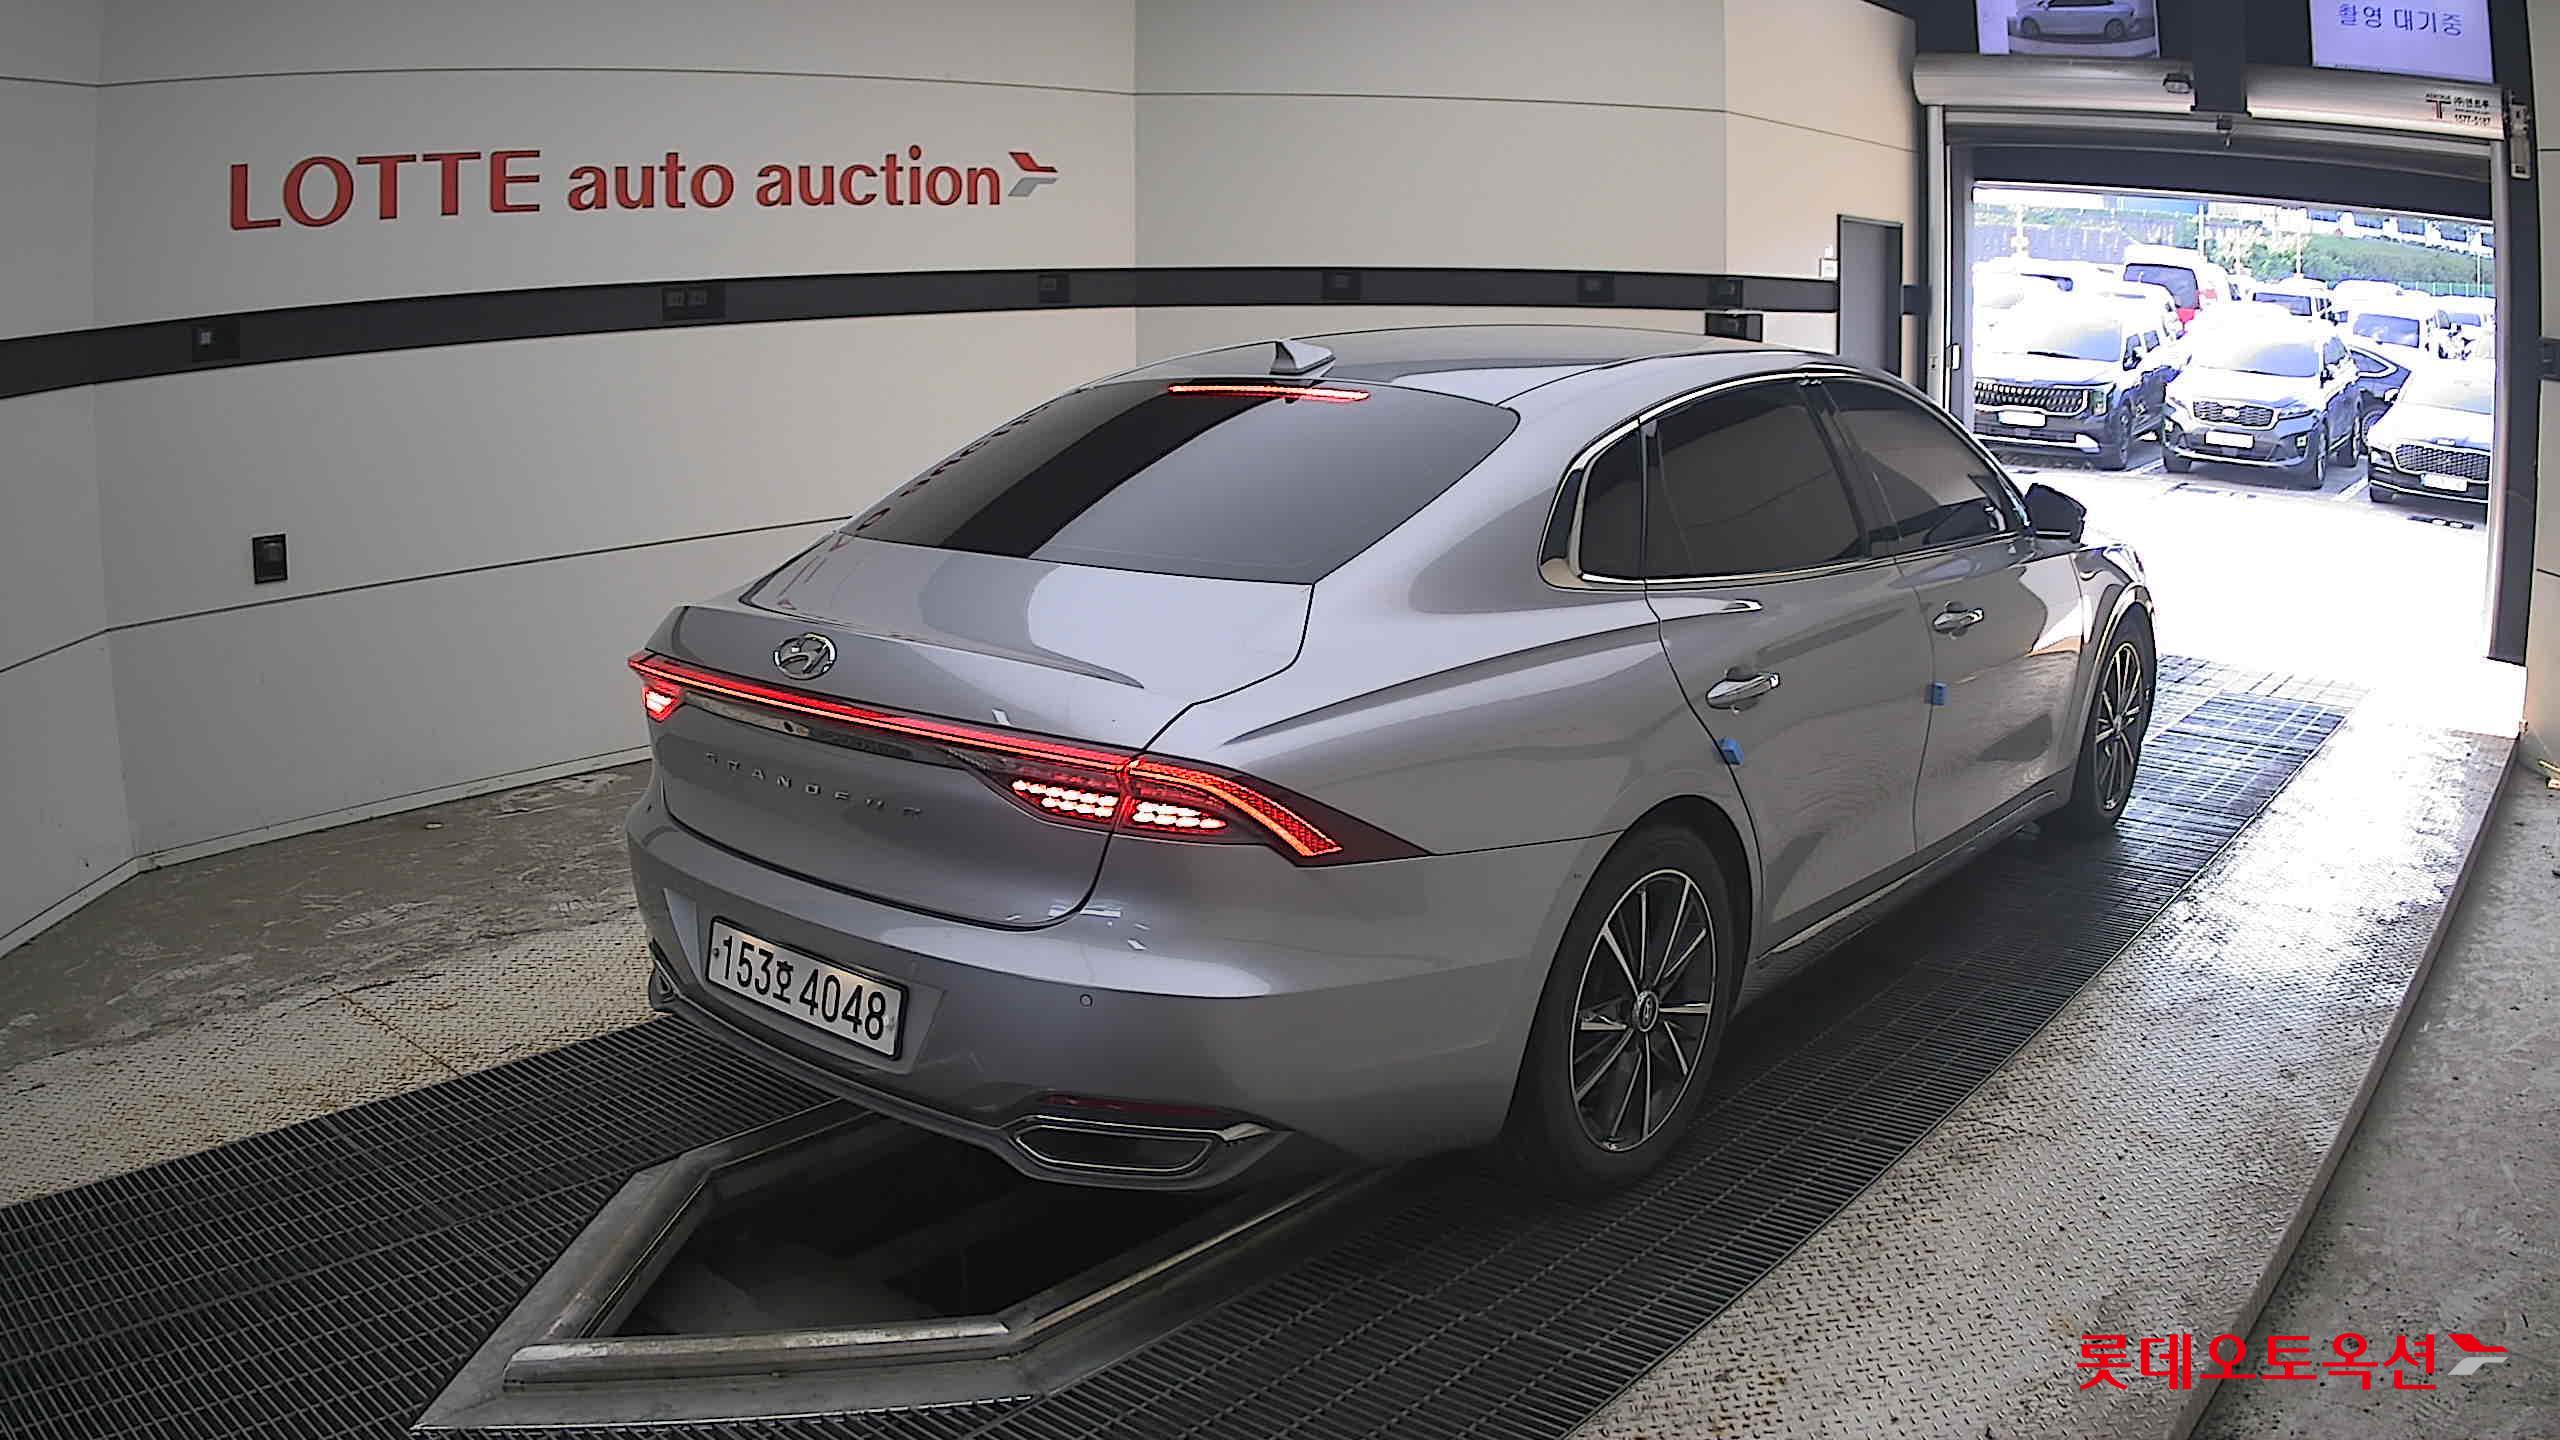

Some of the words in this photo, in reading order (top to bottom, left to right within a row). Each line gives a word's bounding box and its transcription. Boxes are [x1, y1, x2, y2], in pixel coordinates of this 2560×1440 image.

[2393, 8, 2462, 37] 대기중
[231, 151, 542, 231] LOTTE
[568, 152, 735, 210] auto
[755, 145, 1002, 207] auction
[723, 935, 794, 1005] 153호
[799, 968, 887, 1041] 4048
